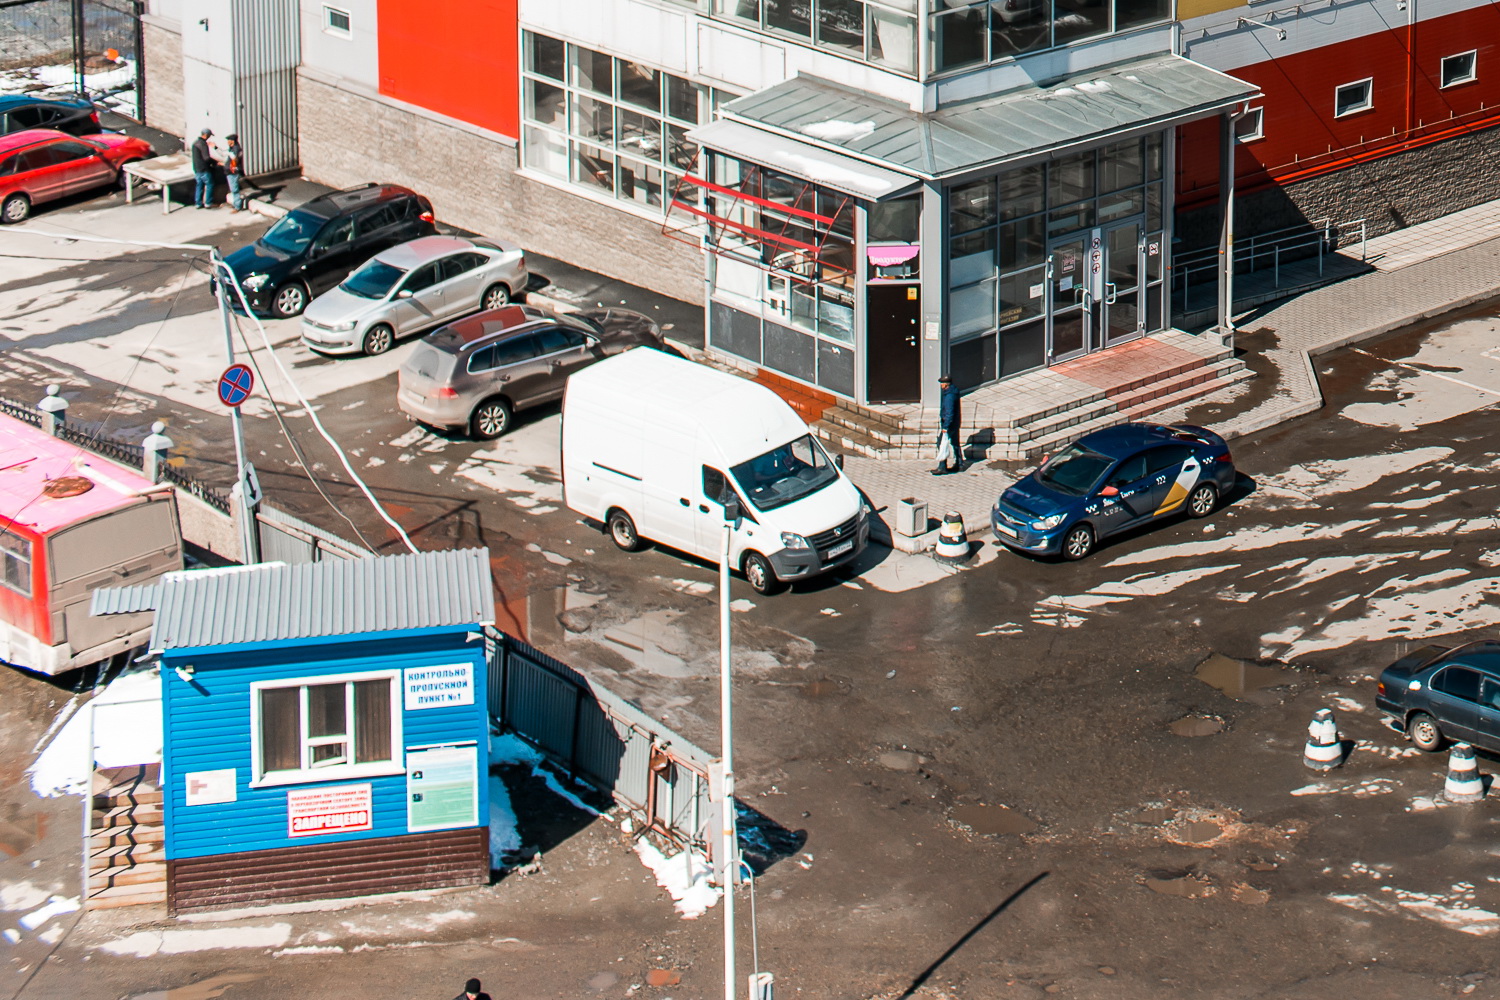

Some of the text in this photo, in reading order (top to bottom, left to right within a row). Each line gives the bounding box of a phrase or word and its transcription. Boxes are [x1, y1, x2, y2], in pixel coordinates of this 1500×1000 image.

[408, 668, 469, 681] КОНТРОЛЬНО-
[410, 679, 468, 693] ПРОПУСКНОЙ
[418, 694, 445, 704] ПУНКТ
[293, 811, 368, 831] ЗАПРЕЩЕНО
